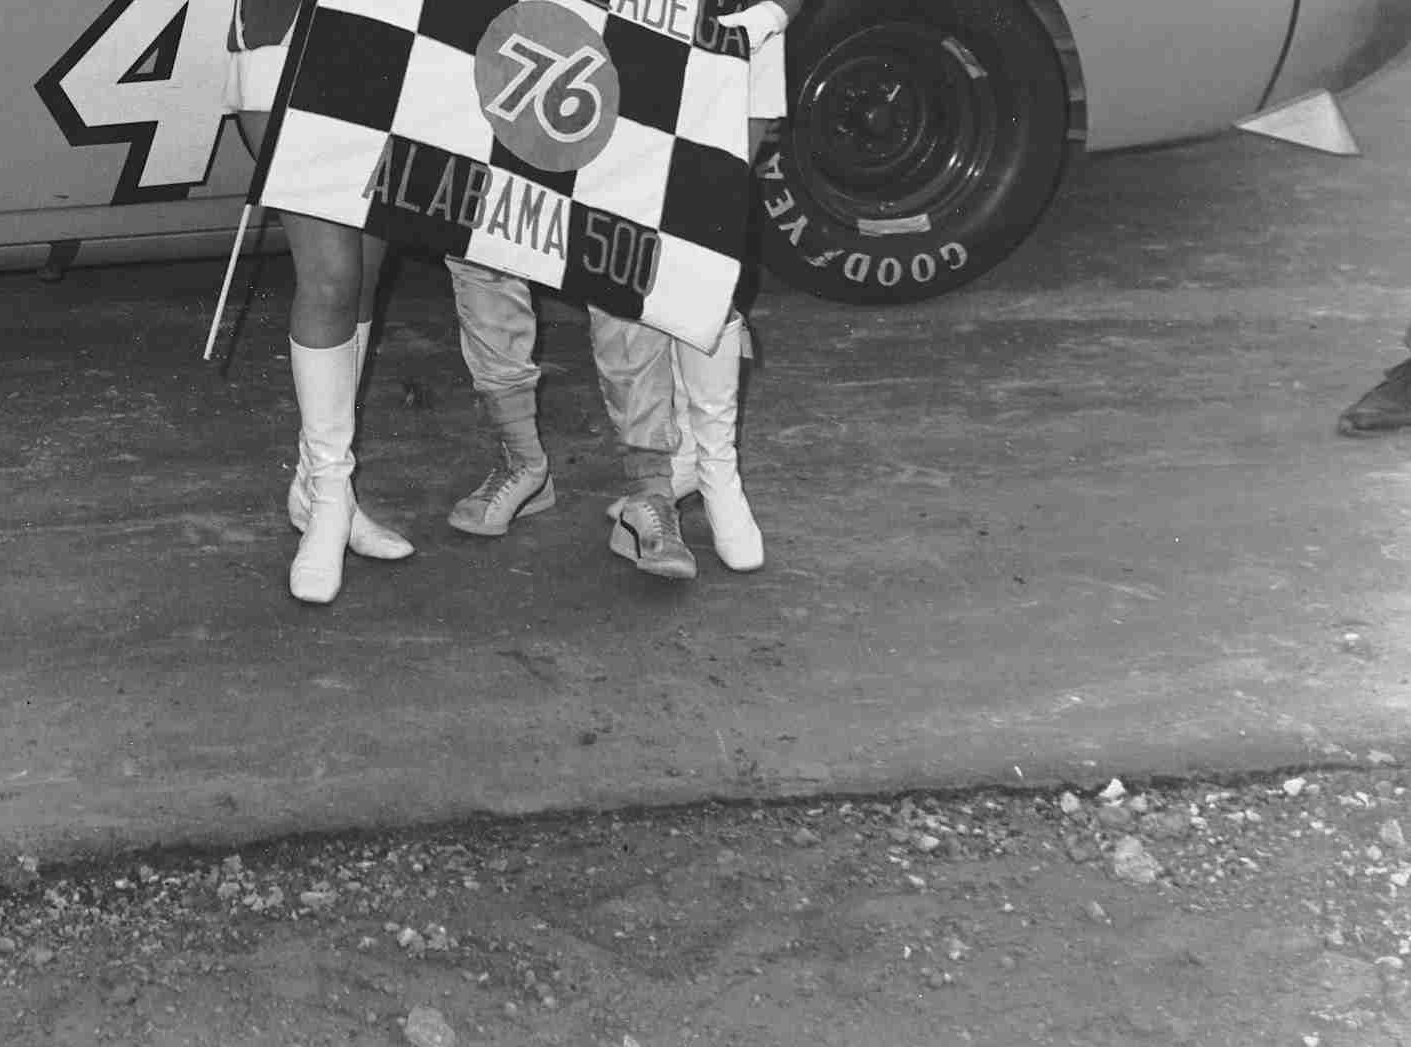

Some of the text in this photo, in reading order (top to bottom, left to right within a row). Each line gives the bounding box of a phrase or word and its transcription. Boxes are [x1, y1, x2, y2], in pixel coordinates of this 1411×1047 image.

[485, 32, 605, 143] 76
[361, 144, 662, 298] ALABAMA 500
[757, 150, 969, 287] GOODYEA
